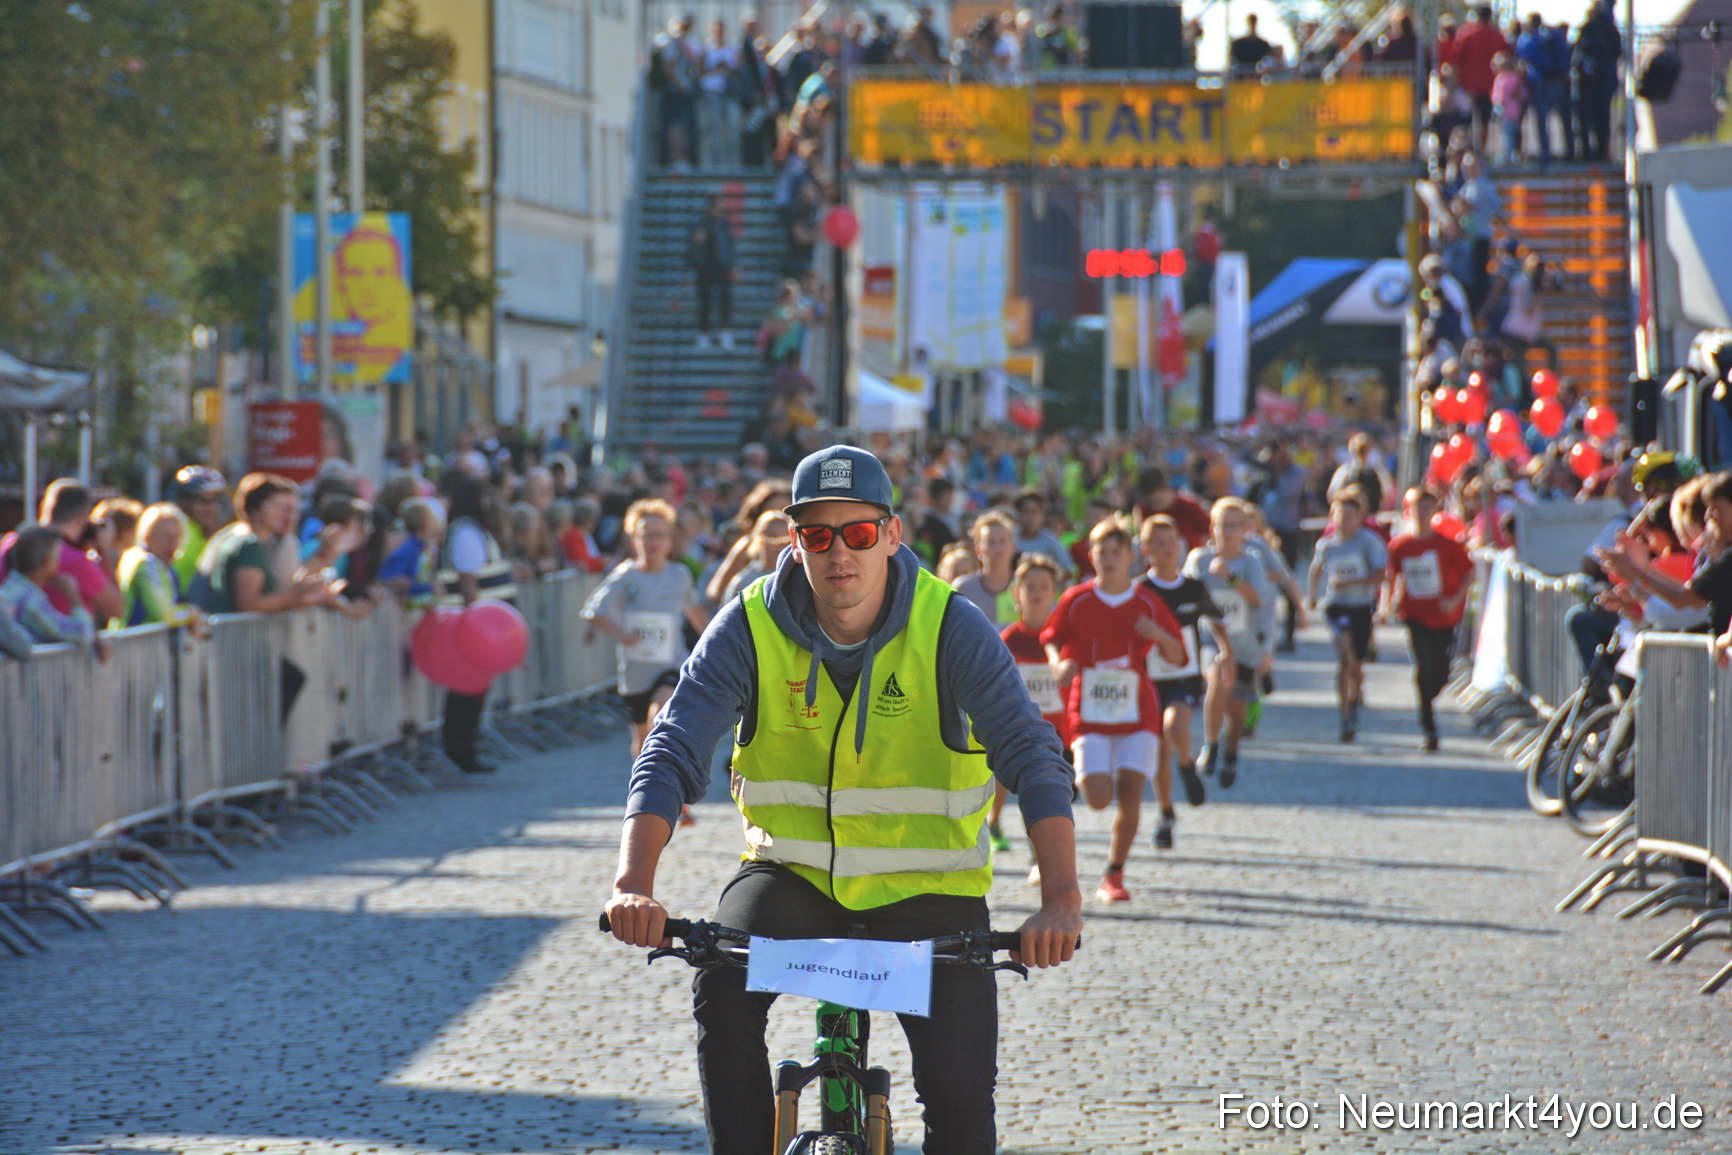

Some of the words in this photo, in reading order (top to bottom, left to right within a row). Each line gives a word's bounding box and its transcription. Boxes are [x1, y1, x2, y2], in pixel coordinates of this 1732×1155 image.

[1032, 101, 1225, 146] START
[821, 469, 851, 479] ELEMENT
[1090, 683, 1129, 700] 4054
[785, 962, 891, 981] Jugendlauf
